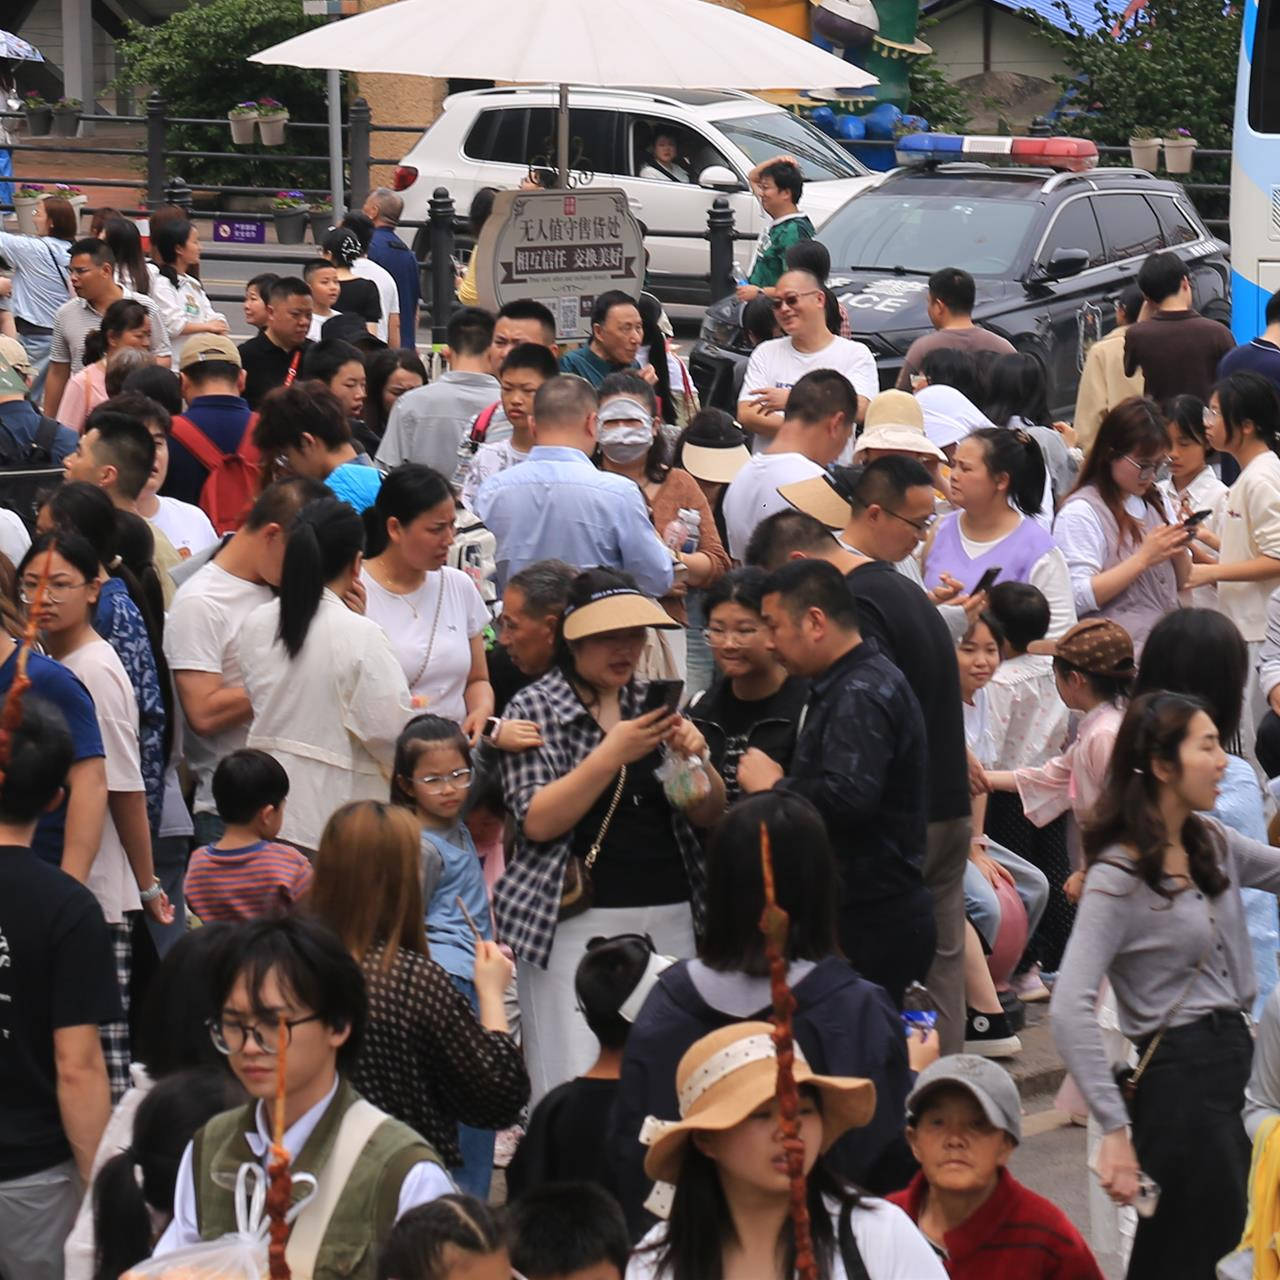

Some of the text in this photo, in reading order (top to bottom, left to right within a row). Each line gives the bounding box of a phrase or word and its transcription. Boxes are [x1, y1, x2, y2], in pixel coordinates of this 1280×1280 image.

[519, 215, 621, 243] 无人值守售货处
[516, 247, 622, 271] 相互信任 交换美好
